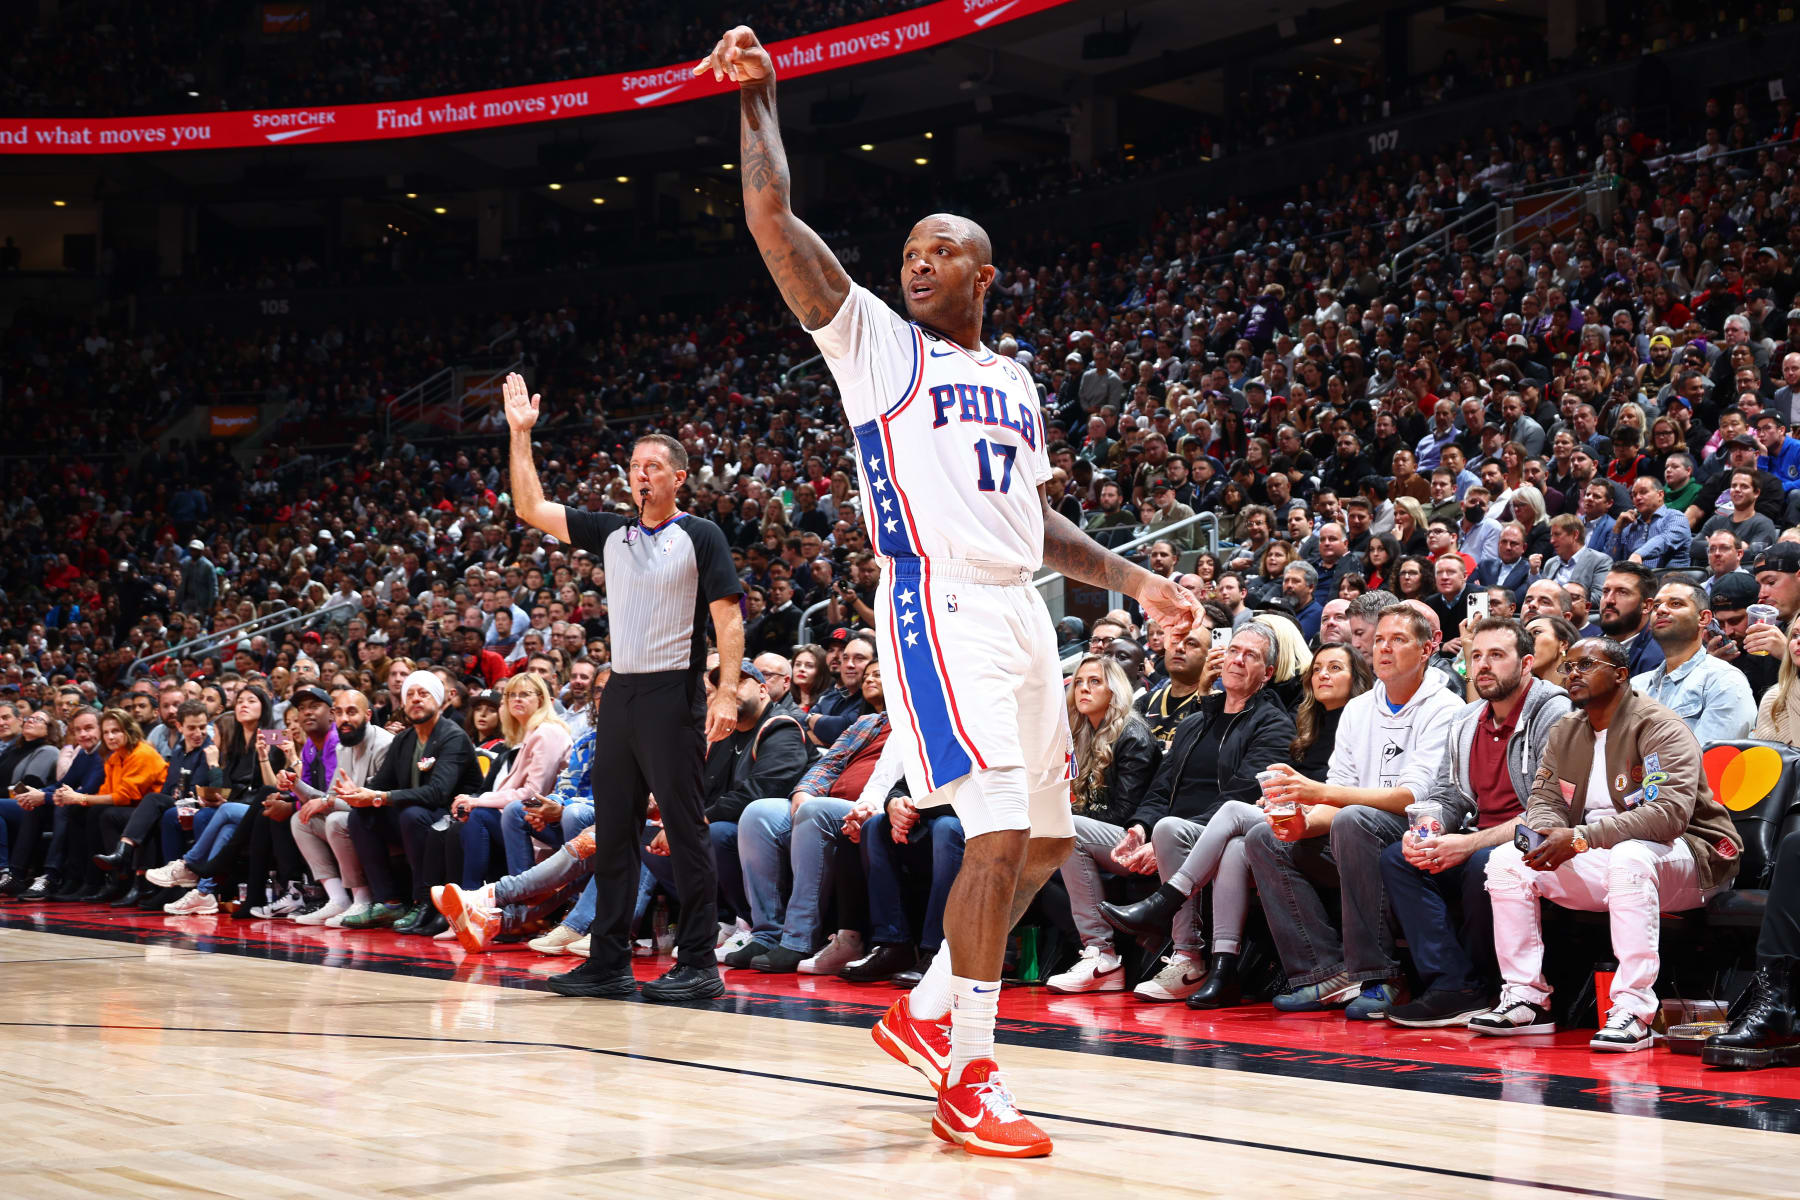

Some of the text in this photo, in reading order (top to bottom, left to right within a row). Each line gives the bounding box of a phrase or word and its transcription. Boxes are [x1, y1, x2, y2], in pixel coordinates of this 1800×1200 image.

[776, 20, 931, 70] what moves you
[252, 111, 336, 128] SPORTCHEK
[376, 91, 589, 129] Find what moves you
[35, 125, 92, 145] what
[99, 126, 166, 144] moves
[170, 125, 211, 146] you
[1368, 129, 1399, 154] 107
[259, 298, 291, 316] 105
[928, 383, 1037, 452] PHILA
[973, 437, 1018, 495] 17
